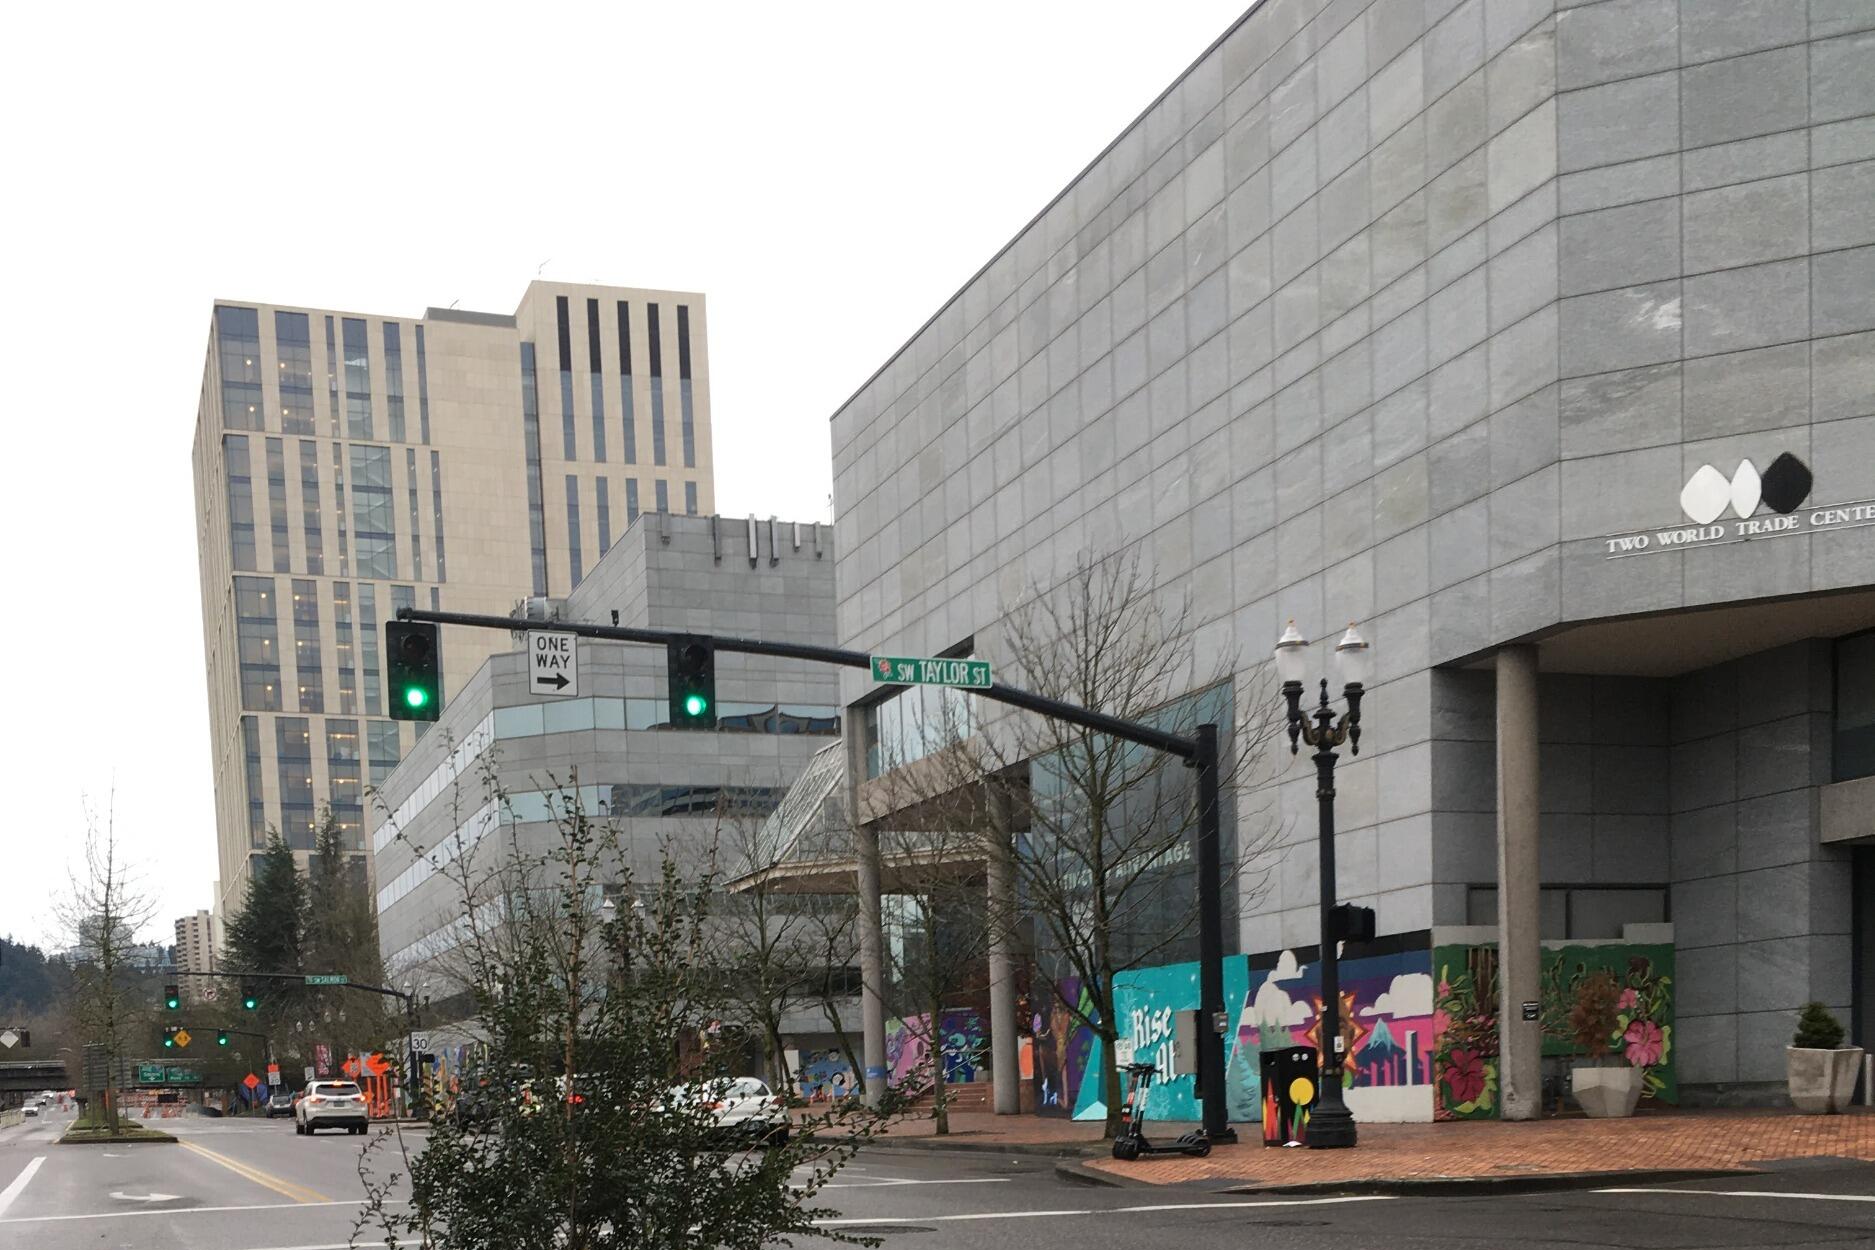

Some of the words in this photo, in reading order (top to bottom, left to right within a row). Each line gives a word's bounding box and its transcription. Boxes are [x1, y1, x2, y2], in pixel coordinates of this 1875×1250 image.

[1605, 535, 1649, 553] TWO
[1656, 525, 1725, 546] WORLD
[1736, 515, 1800, 536] TRADE
[537, 636, 569, 652] ONE
[536, 653, 570, 669] WAY
[897, 663, 914, 681] SW
[919, 661, 969, 684] TAYLOR
[972, 667, 987, 685] ST
[1132, 1004, 1173, 1051] Rise
[413, 1038, 428, 1050] 30
